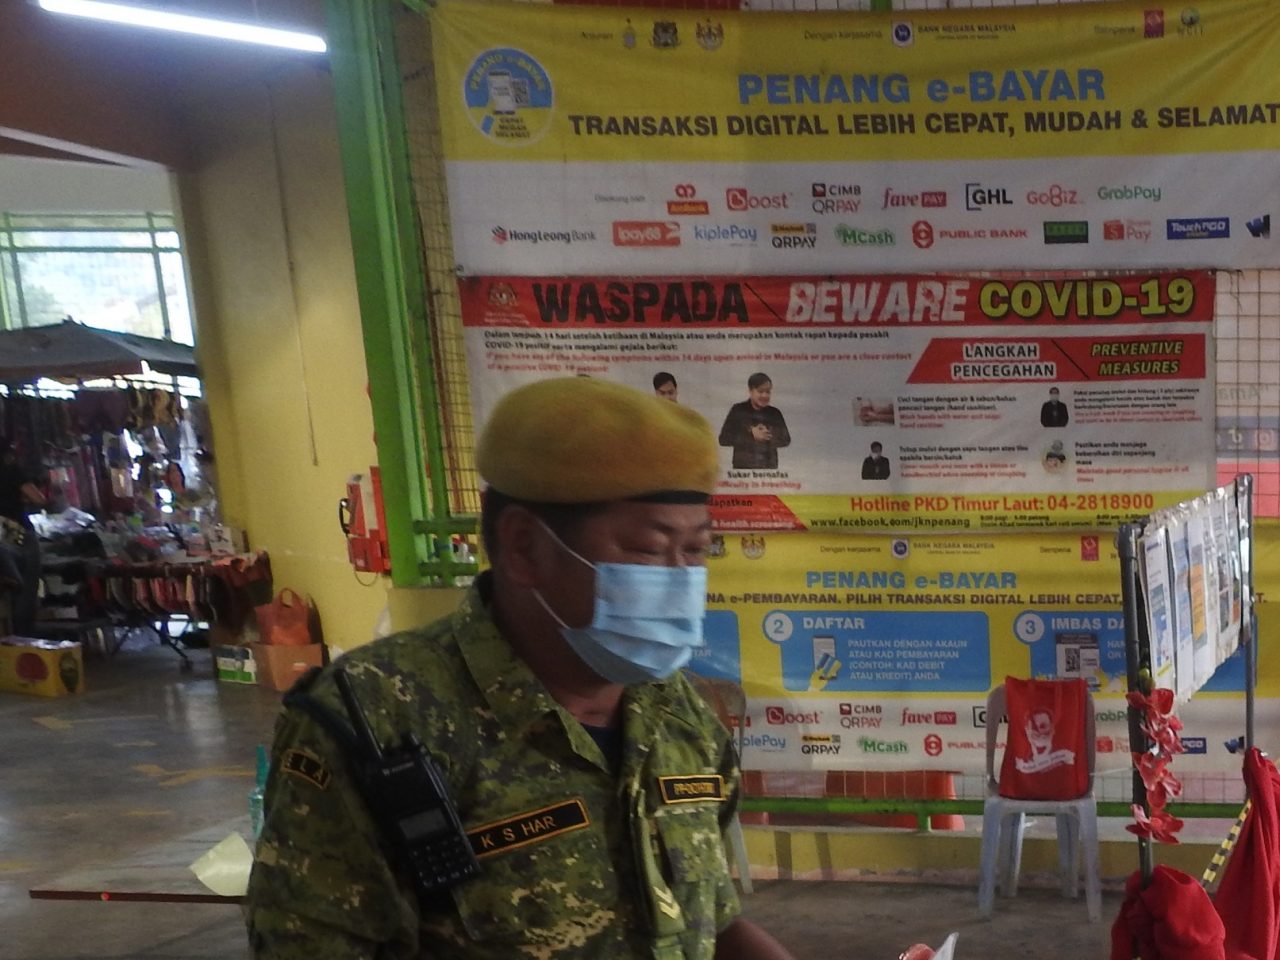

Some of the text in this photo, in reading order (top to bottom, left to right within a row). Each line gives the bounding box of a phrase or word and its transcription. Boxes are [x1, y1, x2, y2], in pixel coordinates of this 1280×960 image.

[738, 70, 1105, 105] PENANG e-BAYAR
[567, 115, 728, 136] TRANSAKSI
[726, 115, 829, 136] DIGITAL
[838, 114, 916, 135] LEBIH
[925, 112, 1015, 138] CEPAT,
[1024, 110, 1121, 133] MUDAH
[1131, 108, 1149, 128] &
[829, 185, 861, 196] CIMB
[972, 188, 1014, 205] GHL
[1097, 185, 1162, 203] GrabPay
[881, 187, 919, 210] fave
[812, 200, 861, 215] QRPAY
[694, 224, 758, 243] kiplePay
[939, 228, 1028, 240] PUBLIC BANK
[771, 236, 817, 249] QRPAY
[531, 276, 1195, 323] WASPADA BEWARE COVID-19
[964, 344, 1038, 358] LANGKAH
[1091, 340, 1184, 358] PREVENTIVE
[953, 364, 1055, 378] PENCEGAHAN
[1098, 360, 1179, 377] MEASURES
[727, 470, 750, 479] Sukar
[850, 493, 1154, 512] Hotline PKD Timur Laut: 04-2818900
[809, 517, 972, 529] www.facebook.com/jknpenang
[806, 571, 1018, 590] PENANG e-BAYAR
[730, 592, 842, 604] e-PEMBAYARAN.
[846, 592, 882, 604] PILIH
[886, 592, 966, 604] TRANSAKSI
[970, 593, 1024, 605] DIGITAL
[1029, 593, 1071, 604] LEBIH
[1075, 593, 1123, 606] CEPAT,
[773, 617, 866, 634] 2 DAFTAR
[1025, 620, 1036, 636] 3
[1051, 617, 1102, 631] IMBAS
[896, 650, 960, 659] PEMBAYARAN
[896, 660, 917, 670] KAD
[914, 671, 941, 681] ANDA
[854, 704, 883, 715] CIMB
[900, 707, 933, 726] fave
[840, 717, 883, 730] QRPAY
[802, 744, 841, 756] QRPAY
[864, 740, 909, 753] MCash
[480, 815, 557, 850] K S HAR
